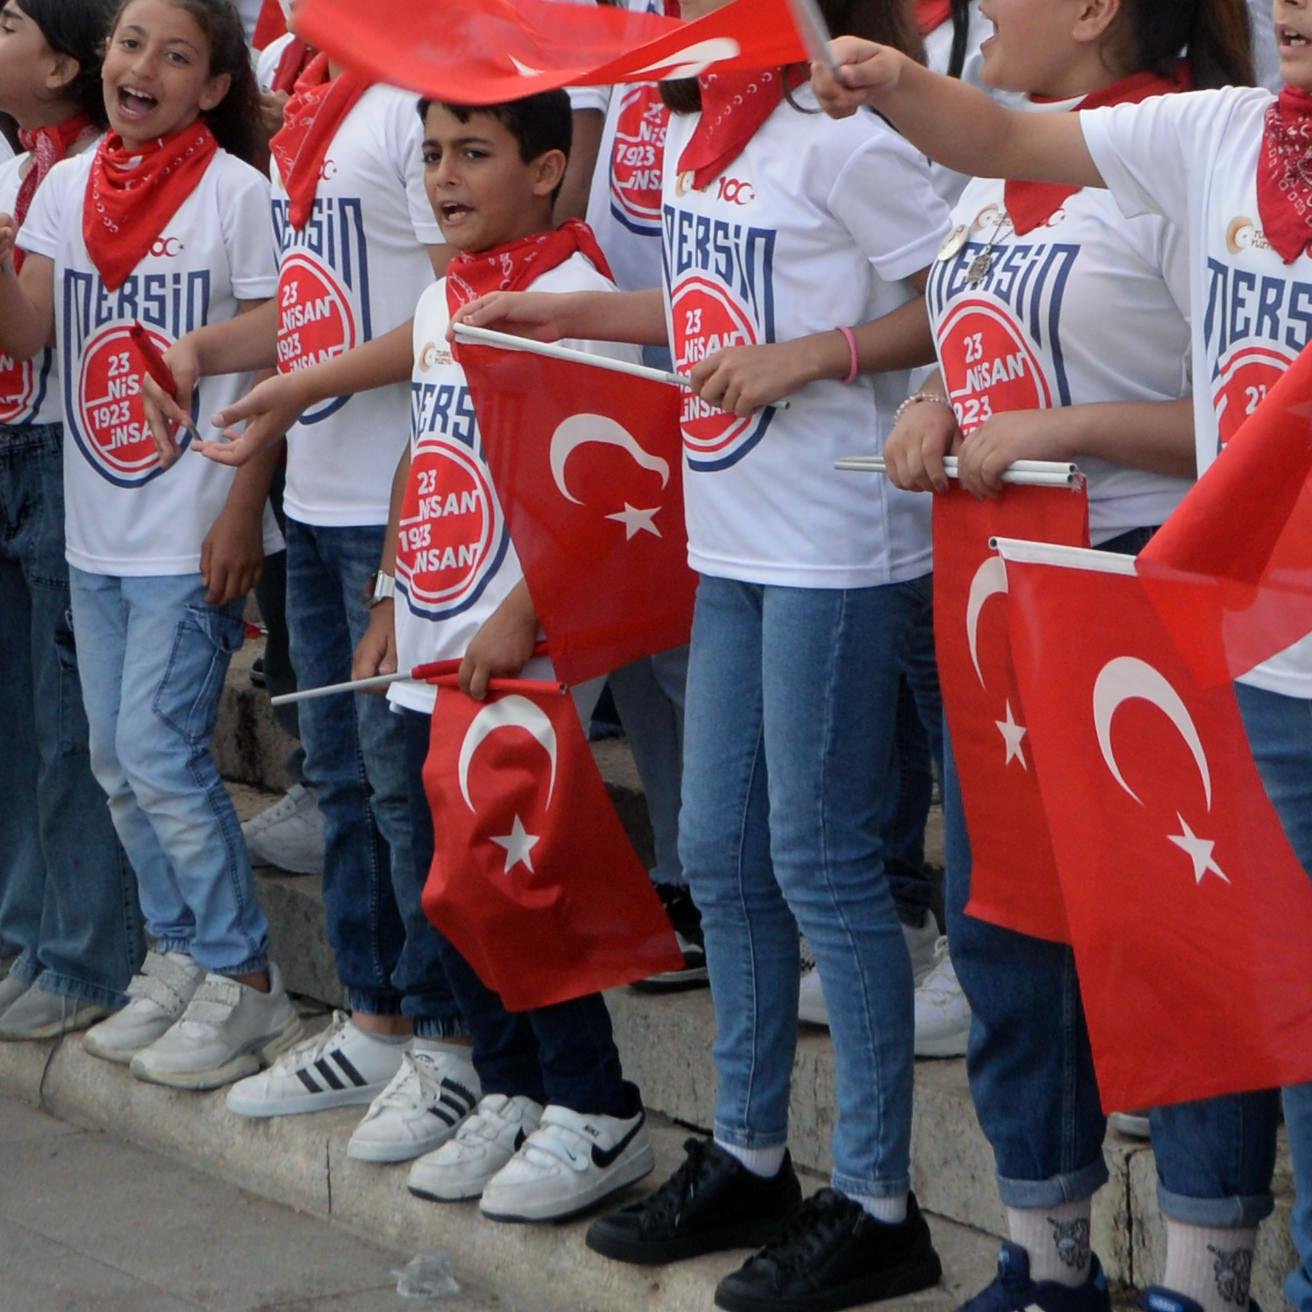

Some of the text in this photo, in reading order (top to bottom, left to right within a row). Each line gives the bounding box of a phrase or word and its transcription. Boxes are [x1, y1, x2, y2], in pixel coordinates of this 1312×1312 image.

[282, 281, 298, 307] 23
[685, 308, 702, 336] 23
[963, 332, 983, 363] 23
[108, 352, 130, 377] 23
[108, 374, 143, 399] NiS
[92, 401, 131, 429] 1923
[953, 396, 992, 426] 923
[110, 423, 153, 448] iNSA
[417, 469, 437, 495] 23
